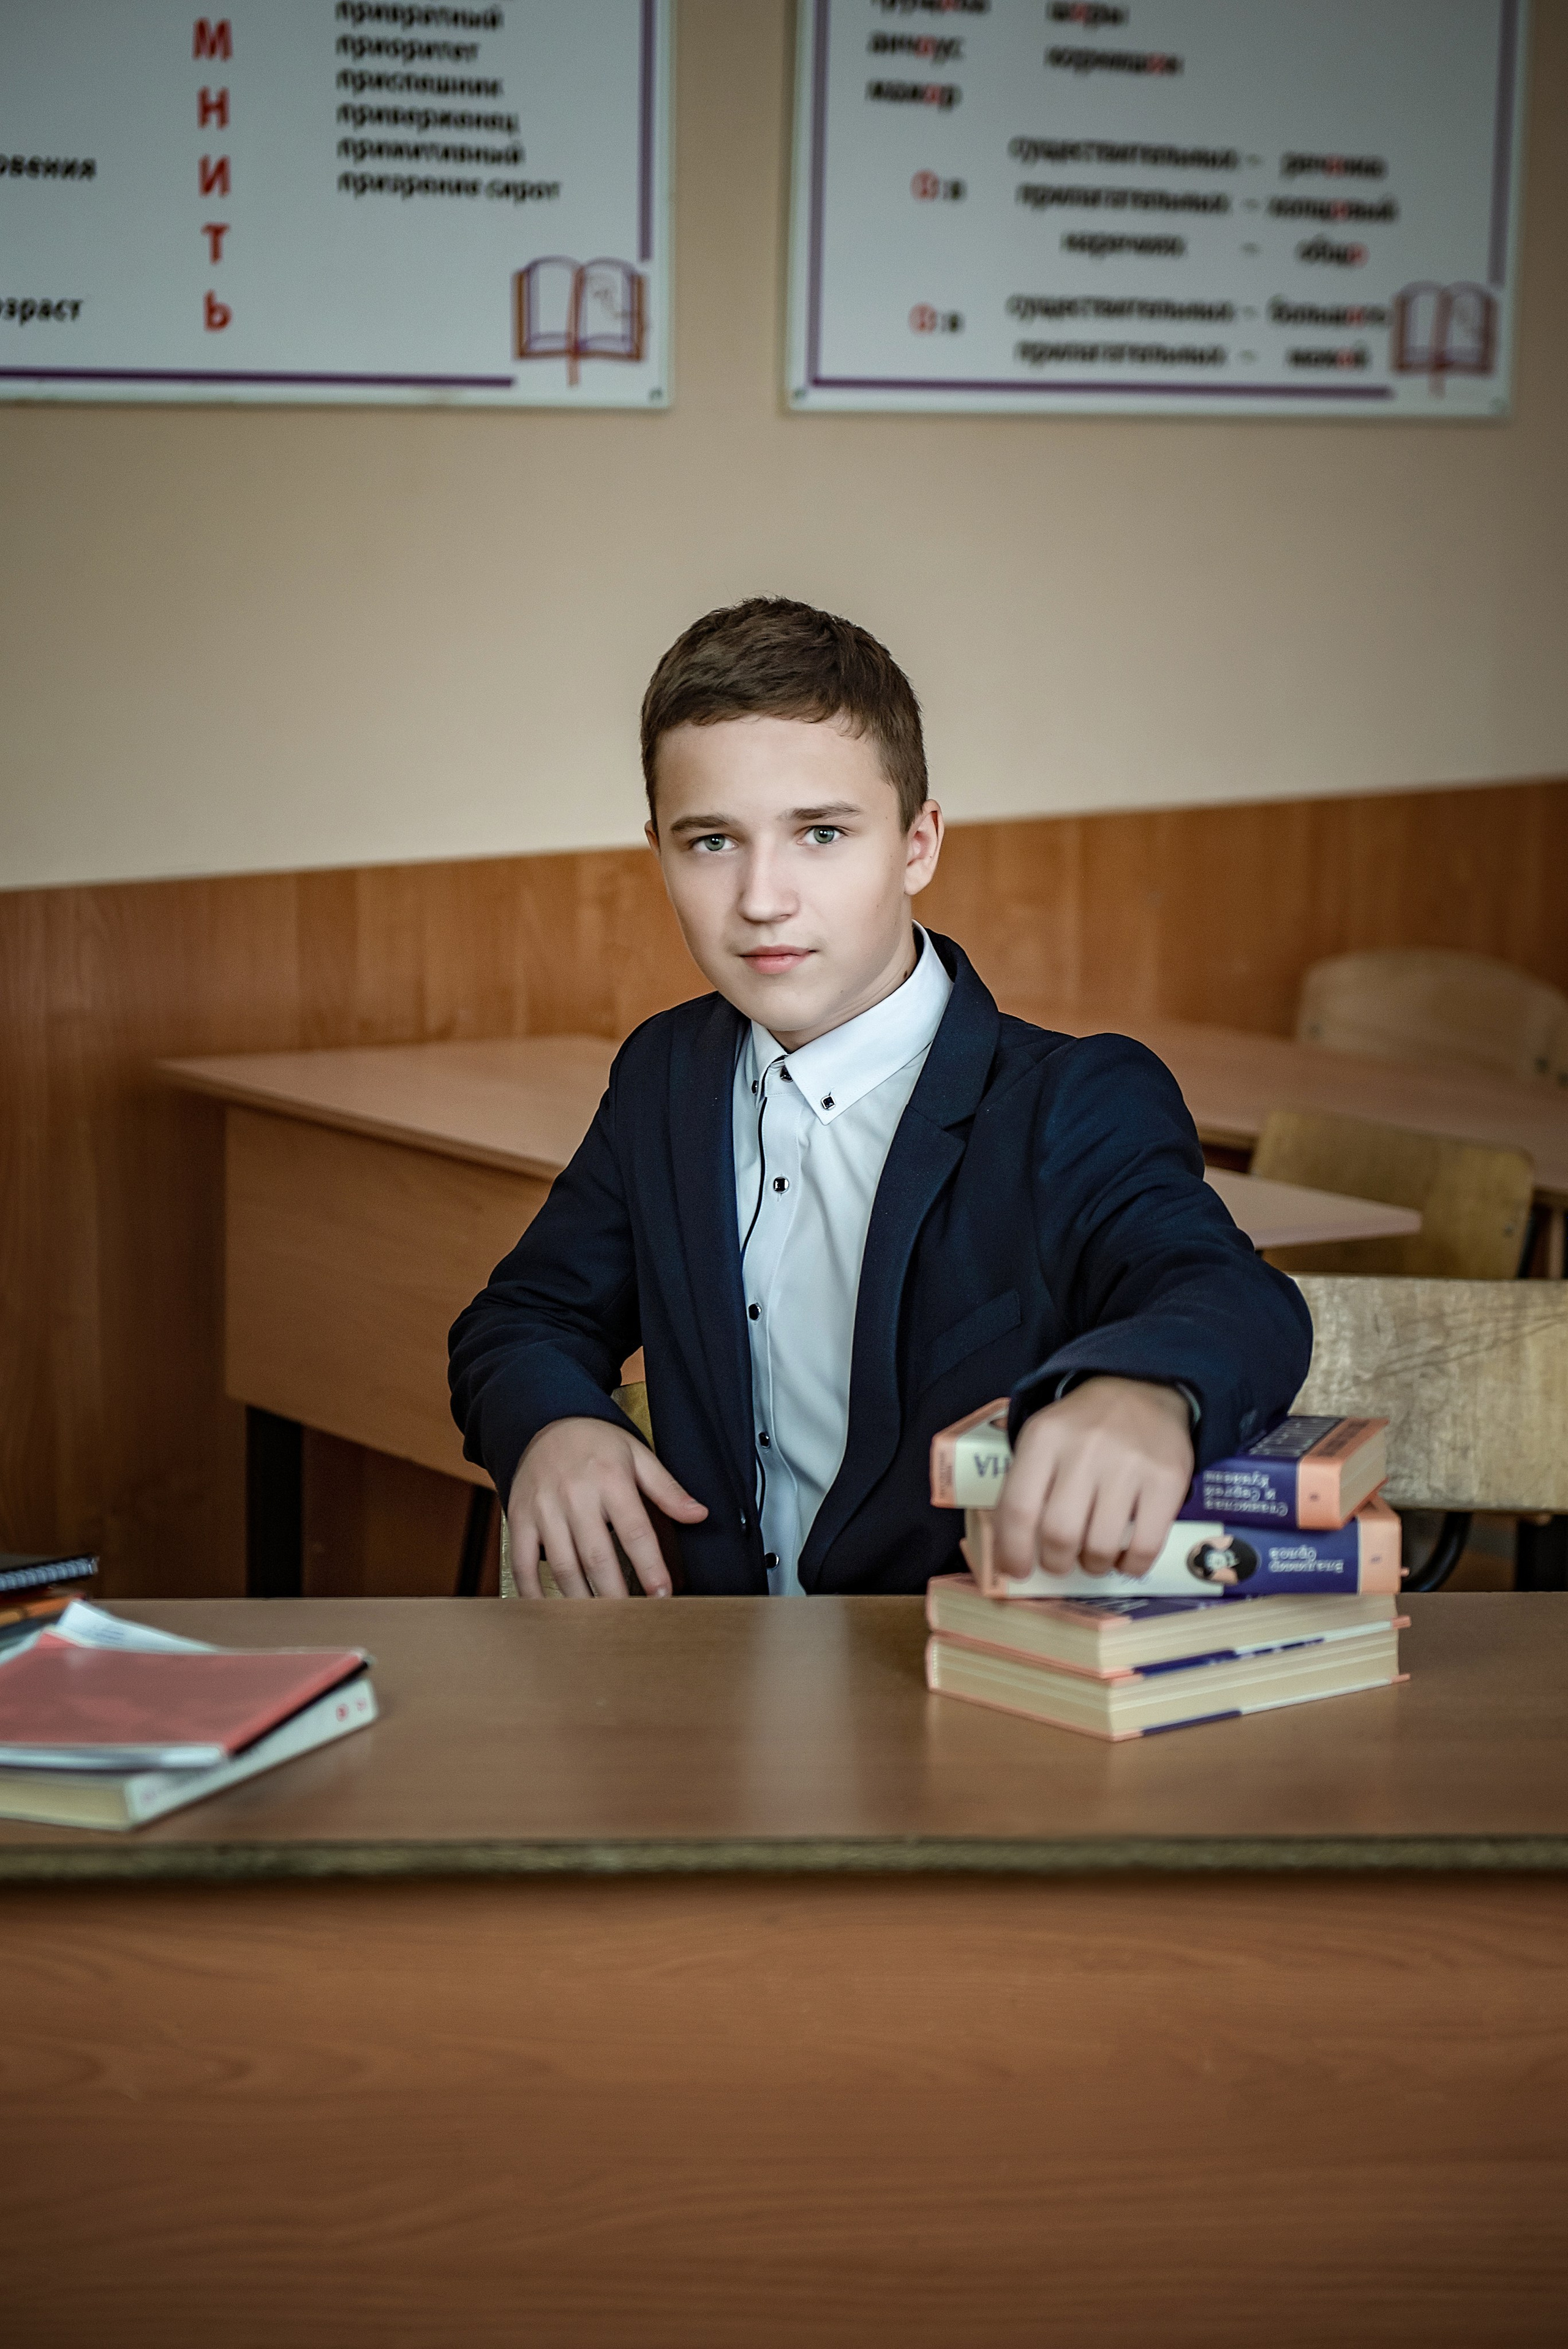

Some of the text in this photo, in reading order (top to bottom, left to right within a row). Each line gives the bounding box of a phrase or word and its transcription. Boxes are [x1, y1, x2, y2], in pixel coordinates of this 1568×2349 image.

[336, 34, 478, 63] приоритет
[337, 104, 518, 135] приверженец
[337, 138, 524, 165] примитивный
[1009, 137, 1241, 169] существительных
[1017, 183, 1232, 213] прилагательных
[1008, 295, 1238, 324] существительных
[1017, 341, 1228, 368] прилагательных
[1204, 1484, 1261, 1501] Сергей
[1204, 1498, 1288, 1517] Станислав
[1268, 1545, 1316, 1561] Орлов
[1268, 1559, 1344, 1573] Владимир
